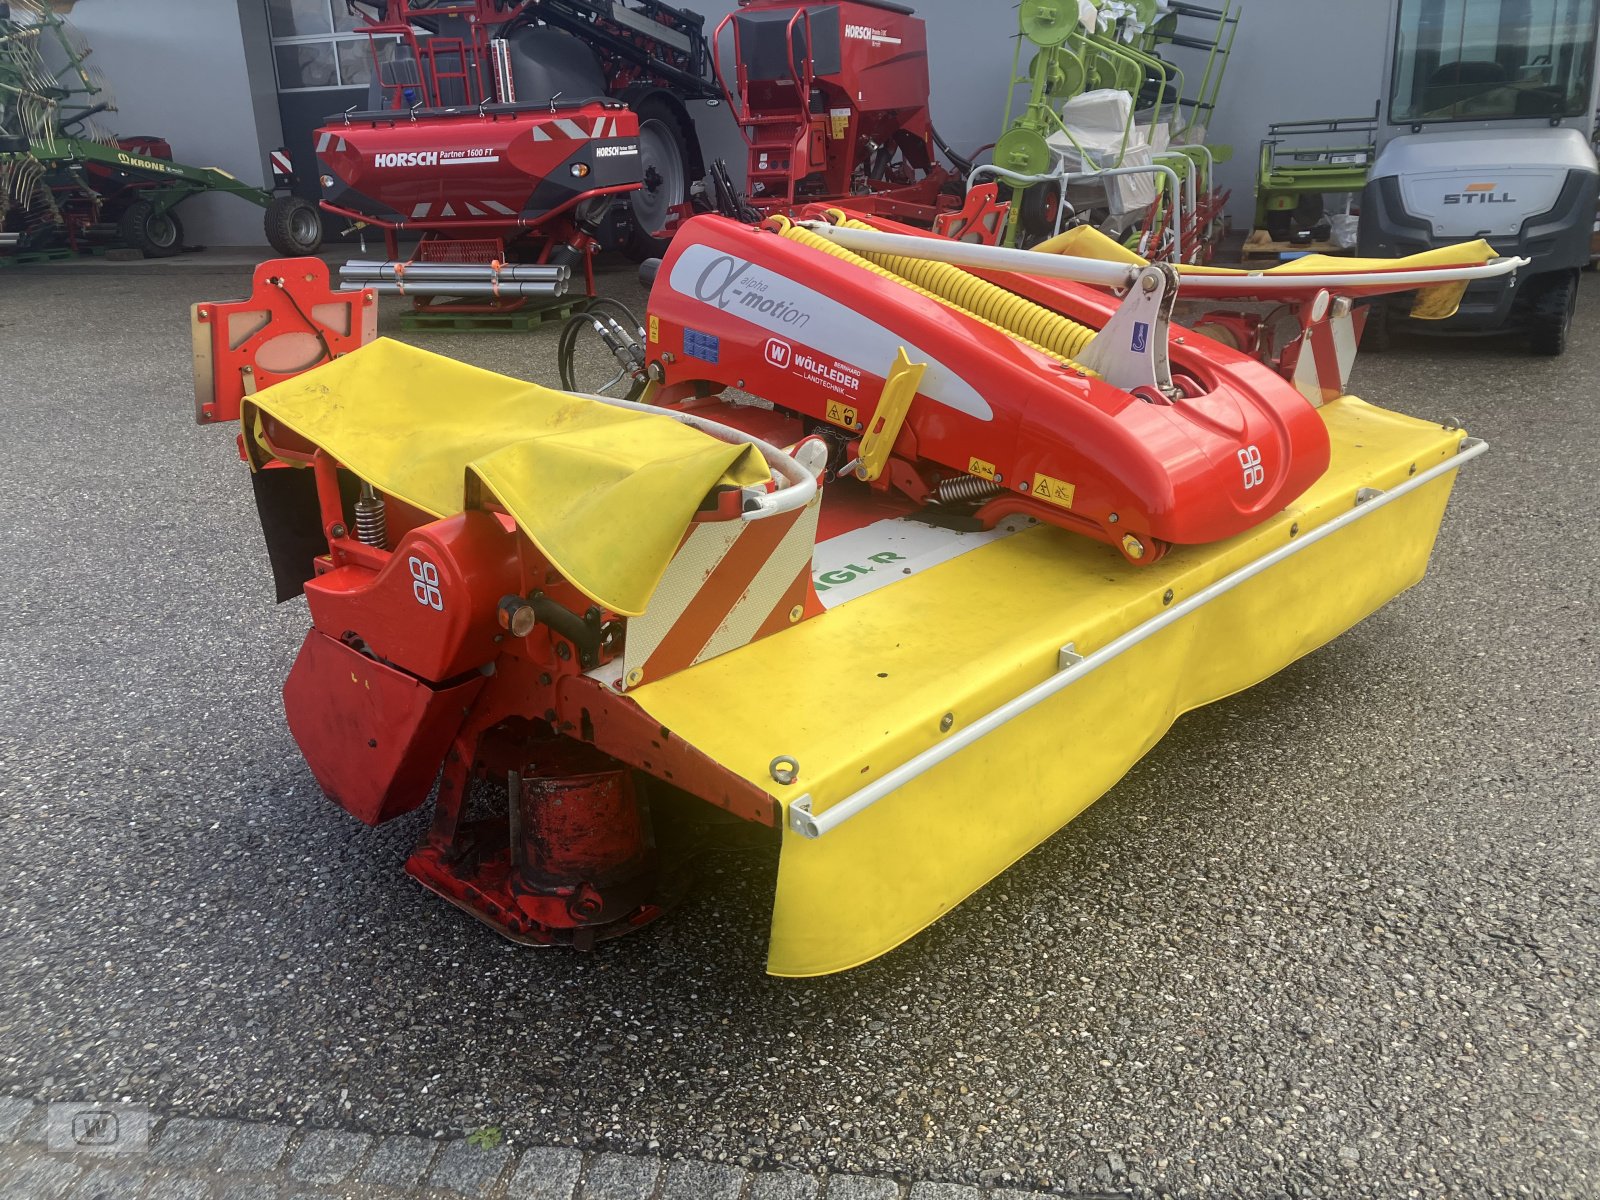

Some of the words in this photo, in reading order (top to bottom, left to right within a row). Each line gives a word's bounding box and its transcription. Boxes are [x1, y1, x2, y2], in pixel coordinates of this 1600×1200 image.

[845, 24, 872, 40] HORSCH
[375, 151, 438, 168] HORSCH
[440, 150, 465, 159] Partner
[467, 149, 484, 157] 1600
[484, 148, 494, 156] FT
[596, 146, 620, 158] HORSCH
[130, 157, 166, 172] KRONE
[1443, 192, 1517, 205] STILL
[740, 275, 769, 293] alpha
[771, 343, 786, 362] W
[794, 354, 860, 391] WÖLFLEDER
[833, 361, 861, 377] BERNHARD
[803, 372, 845, 395] LANDTECHNIK
